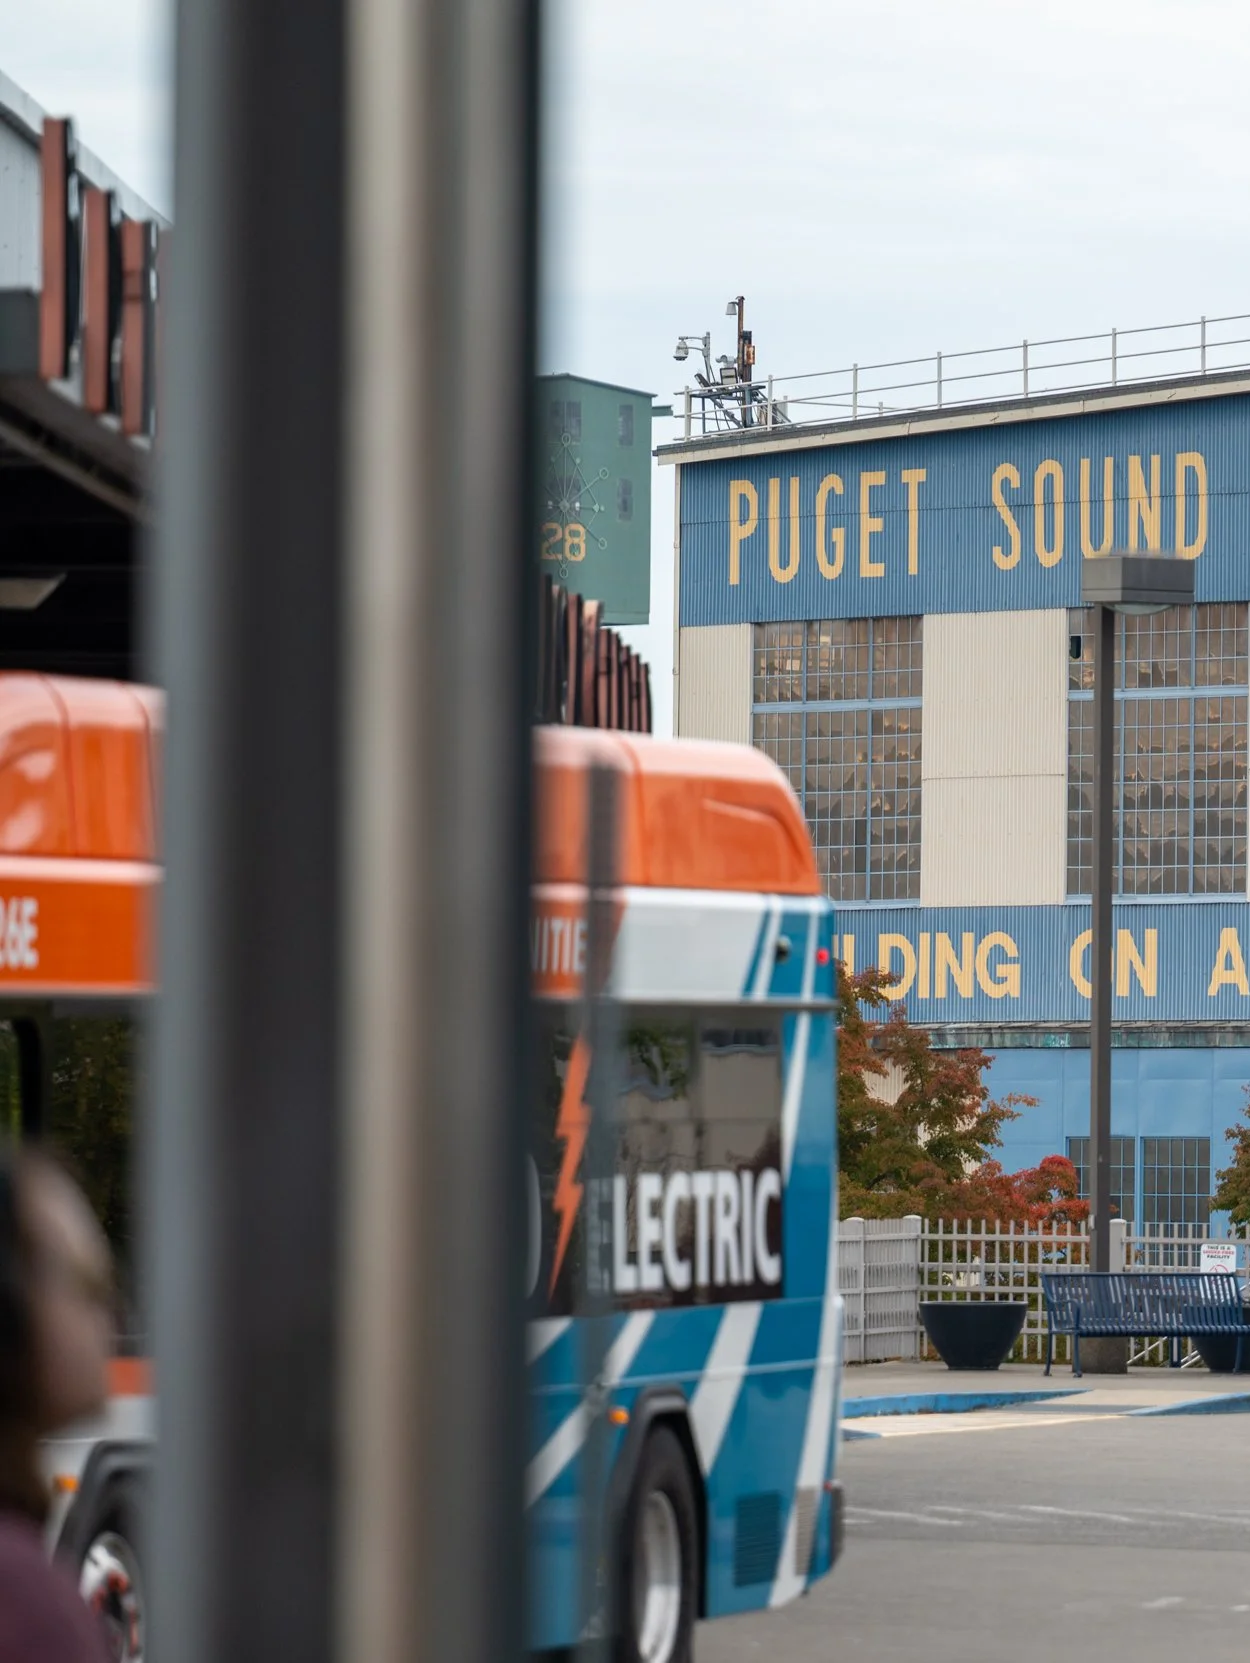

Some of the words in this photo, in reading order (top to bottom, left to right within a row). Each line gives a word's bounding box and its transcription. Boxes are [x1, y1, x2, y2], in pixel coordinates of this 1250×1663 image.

[541, 521, 586, 562] 28
[728, 468, 927, 586] PUGET
[991, 451, 1208, 571] SOUND
[833, 930, 1021, 1001] DING
[1069, 928, 1158, 1000] ON
[1207, 926, 1250, 997] A
